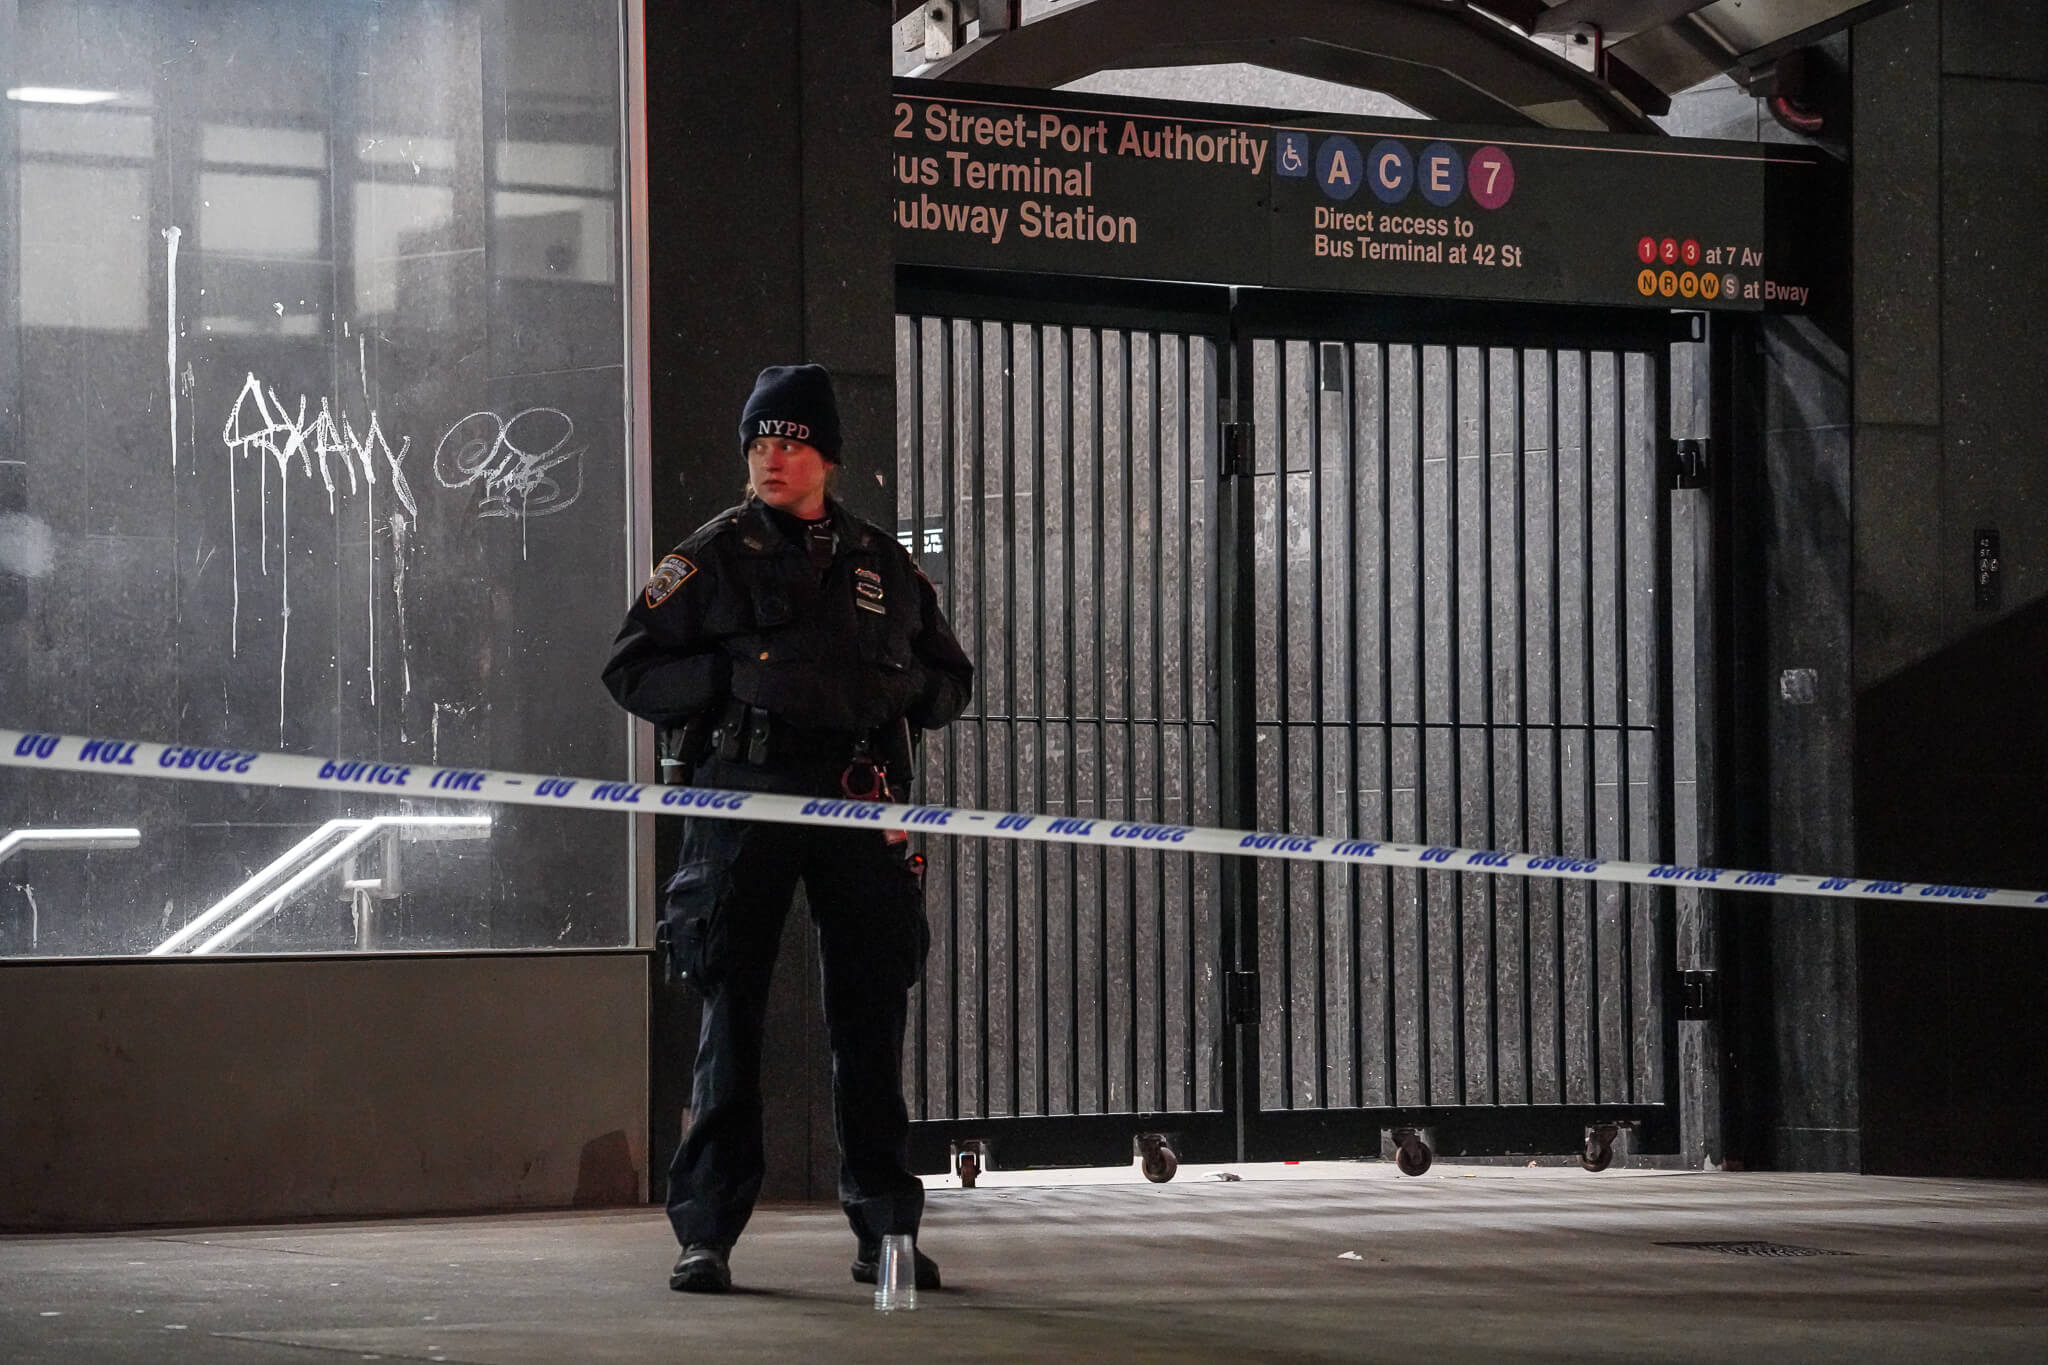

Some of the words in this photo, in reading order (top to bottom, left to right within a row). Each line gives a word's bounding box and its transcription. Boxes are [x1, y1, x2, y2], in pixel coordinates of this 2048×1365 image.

[924, 104, 1108, 154] Street-Port
[1117, 121, 1269, 175] Authority
[893, 152, 940, 186] us
[946, 150, 1092, 197] Terminal
[1327, 150, 1352, 185] A
[1379, 153, 1402, 189] C
[1431, 157, 1451, 191] E
[1482, 161, 1501, 194] 7
[893, 193, 1009, 244] ubway
[1019, 200, 1137, 244] Station
[1314, 206, 1375, 232] Direct
[1379, 215, 1449, 237] access
[1454, 215, 1474, 238] to
[1314, 234, 1354, 257] Bus
[1357, 236, 1443, 263] Terminal
[1449, 244, 1468, 264] at
[1472, 244, 1496, 266] 42
[1501, 245, 1523, 268] St
[1705, 247, 1722, 265] at
[1726, 246, 1737, 265] 7
[1740, 247, 1763, 267] Av
[1743, 283, 1760, 299] at
[1764, 281, 1809, 306] Bway
[758, 419, 810, 441] NYPD
